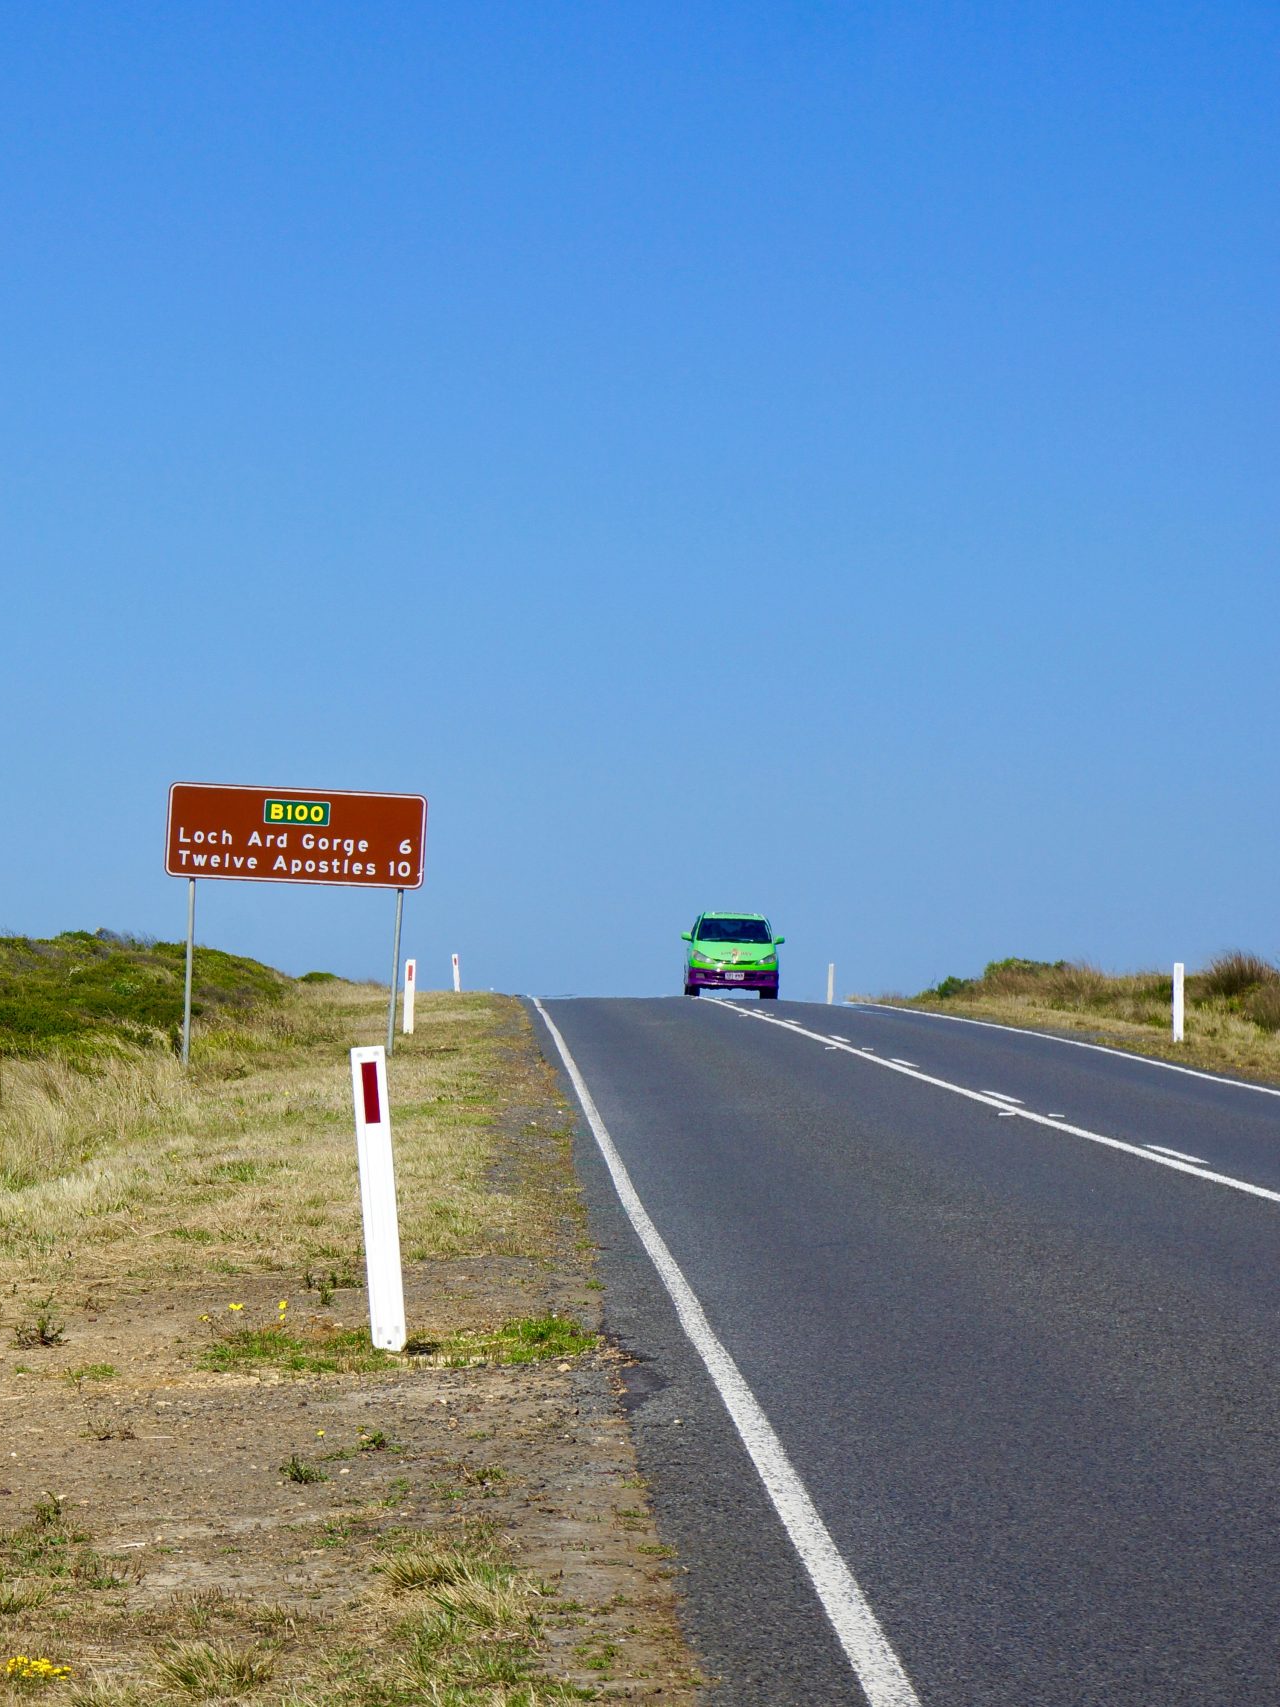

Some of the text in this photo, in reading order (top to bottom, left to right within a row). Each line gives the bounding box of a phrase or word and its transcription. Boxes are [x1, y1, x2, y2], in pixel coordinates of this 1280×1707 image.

[270, 803, 324, 822] B100
[179, 827, 412, 856] Loch Ard Gorge 6
[179, 850, 411, 877] Twelve Apostles 10
